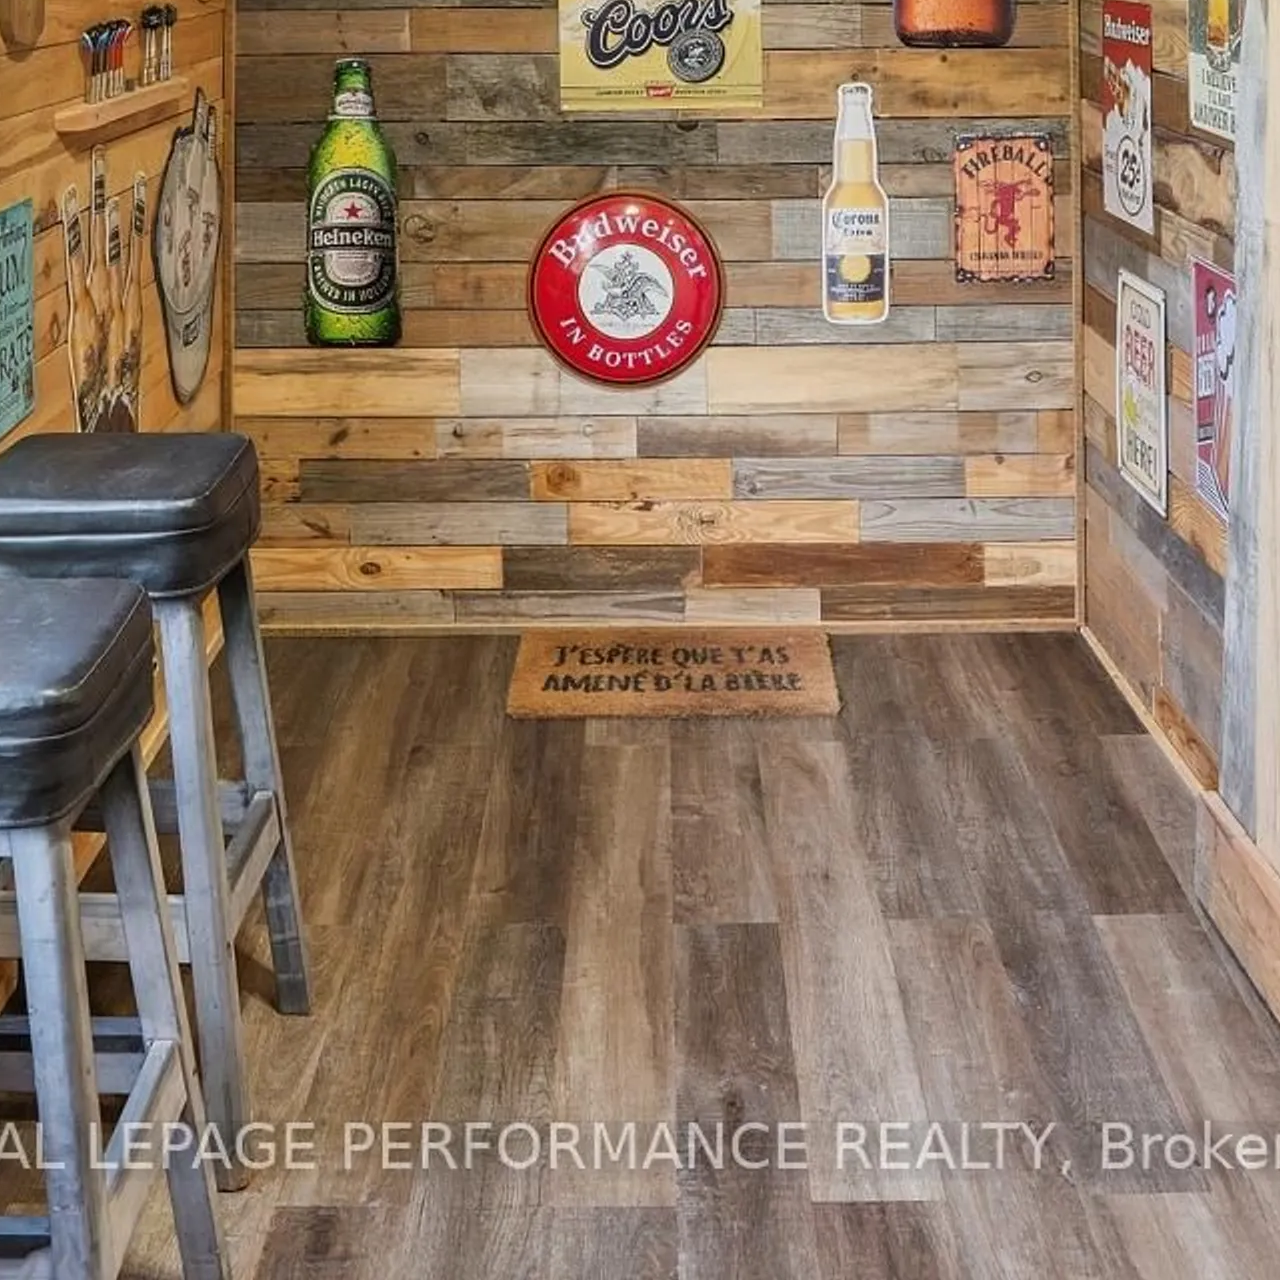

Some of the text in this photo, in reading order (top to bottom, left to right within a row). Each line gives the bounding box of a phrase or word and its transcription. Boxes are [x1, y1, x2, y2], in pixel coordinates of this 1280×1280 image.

[1104, 12, 1150, 46] Budweiser
[961, 144, 1047, 179] FIREBALL
[832, 211, 880, 228] Corona
[313, 228, 393, 247] Heineken
[548, 211, 708, 278] Budweiser
[560, 317, 693, 368] IN BOTTLES
[672, 647, 723, 668] QUE
